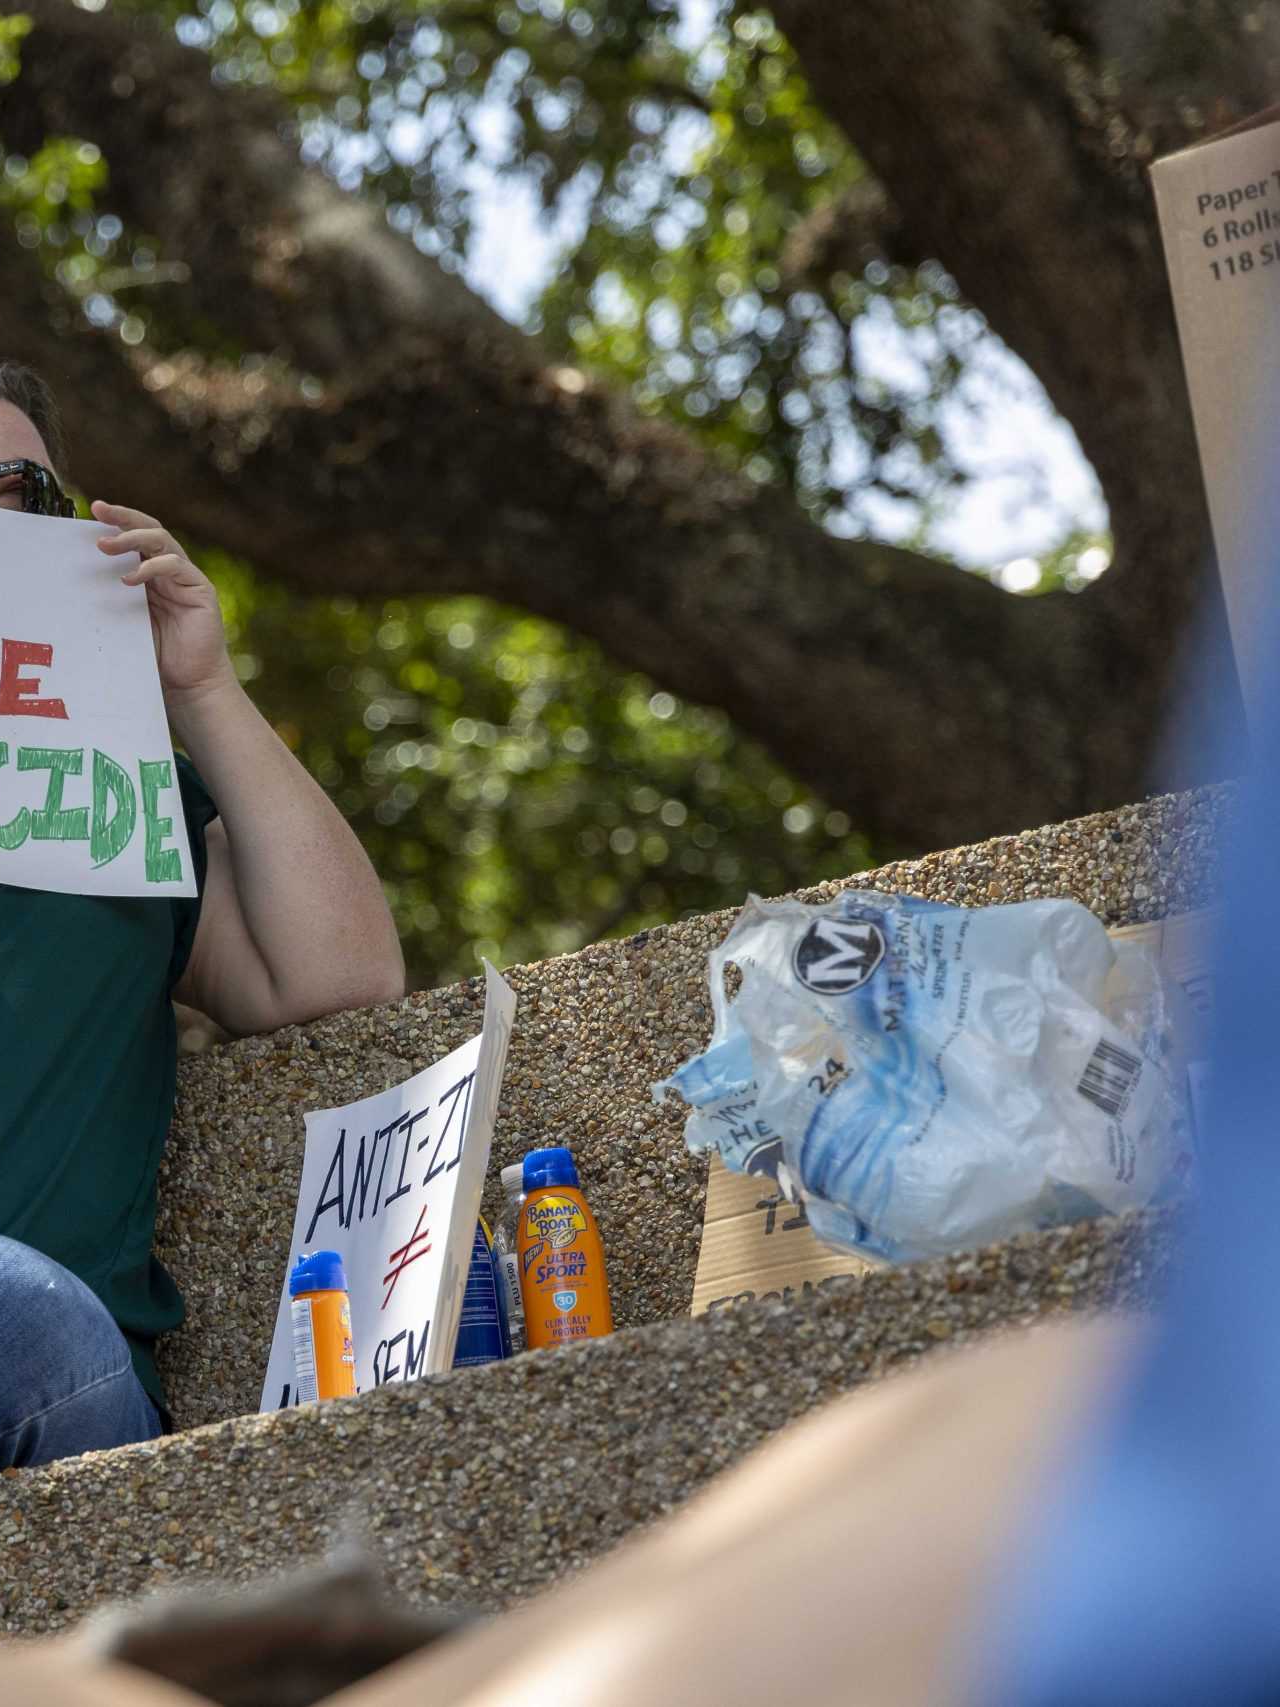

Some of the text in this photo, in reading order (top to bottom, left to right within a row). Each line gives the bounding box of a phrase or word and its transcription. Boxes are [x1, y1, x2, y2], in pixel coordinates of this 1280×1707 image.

[1197, 180, 1269, 215] Paper
[1203, 227, 1218, 248] 6
[1210, 251, 1254, 280] 118
[527, 1204, 579, 1223] BANANA
[536, 1217, 576, 1237] BOAT
[545, 1251, 586, 1264] ULTRA
[536, 1264, 587, 1284] SPORT
[557, 1294, 574, 1306] 30
